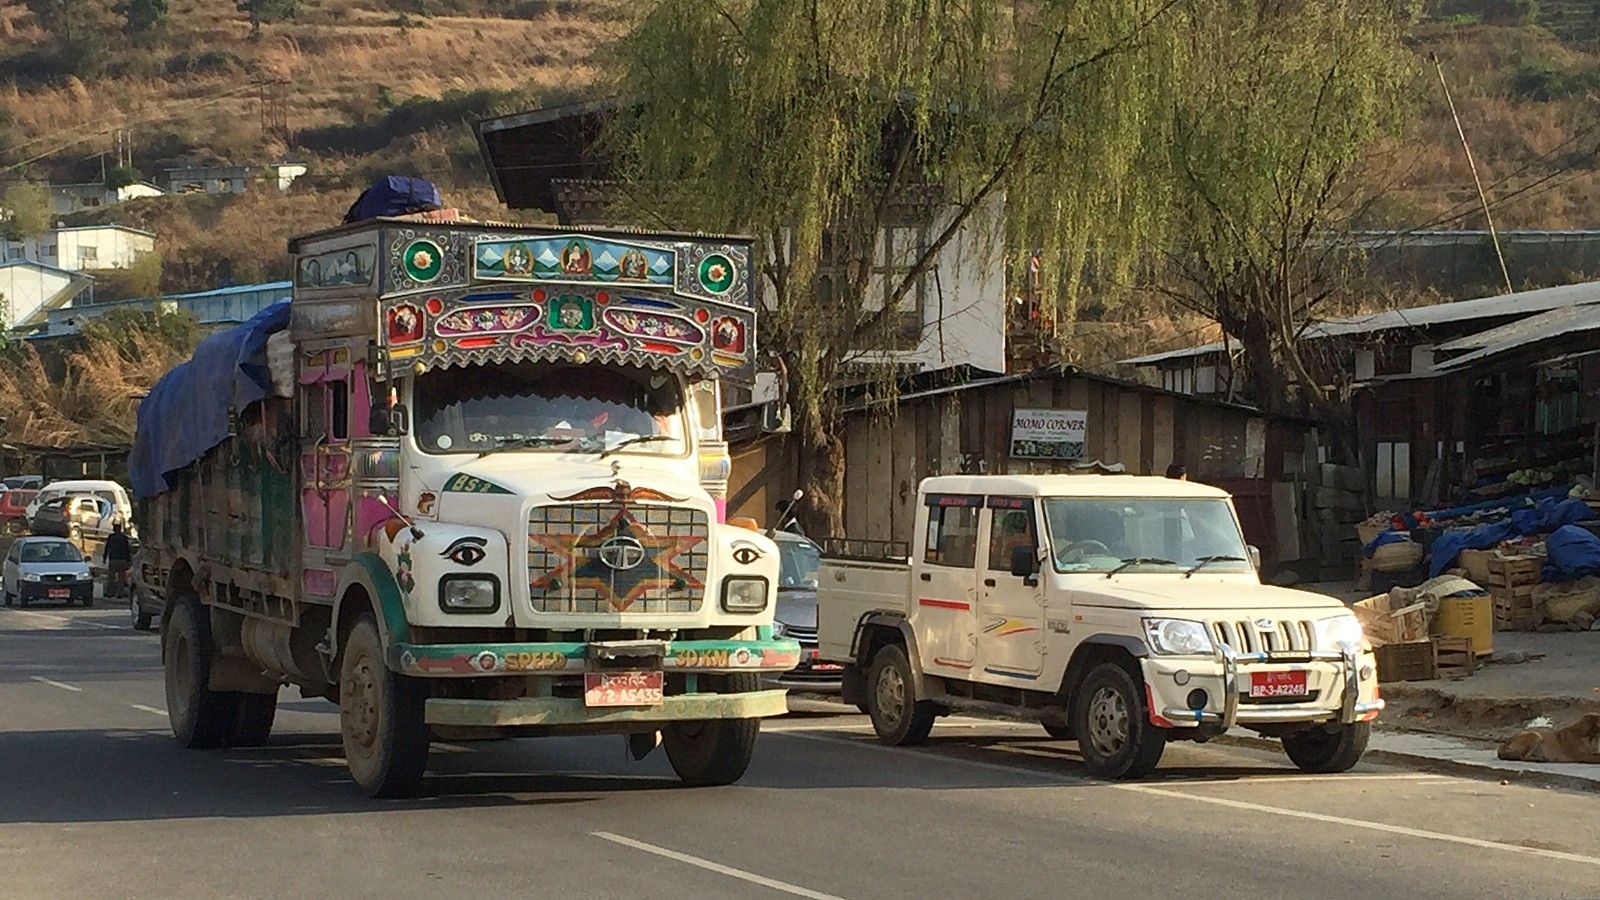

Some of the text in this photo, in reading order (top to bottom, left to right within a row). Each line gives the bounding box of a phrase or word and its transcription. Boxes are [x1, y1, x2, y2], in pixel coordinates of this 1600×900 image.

[1013, 418, 1085, 431] MOMO CORNER
[504, 652, 567, 671] SPEED
